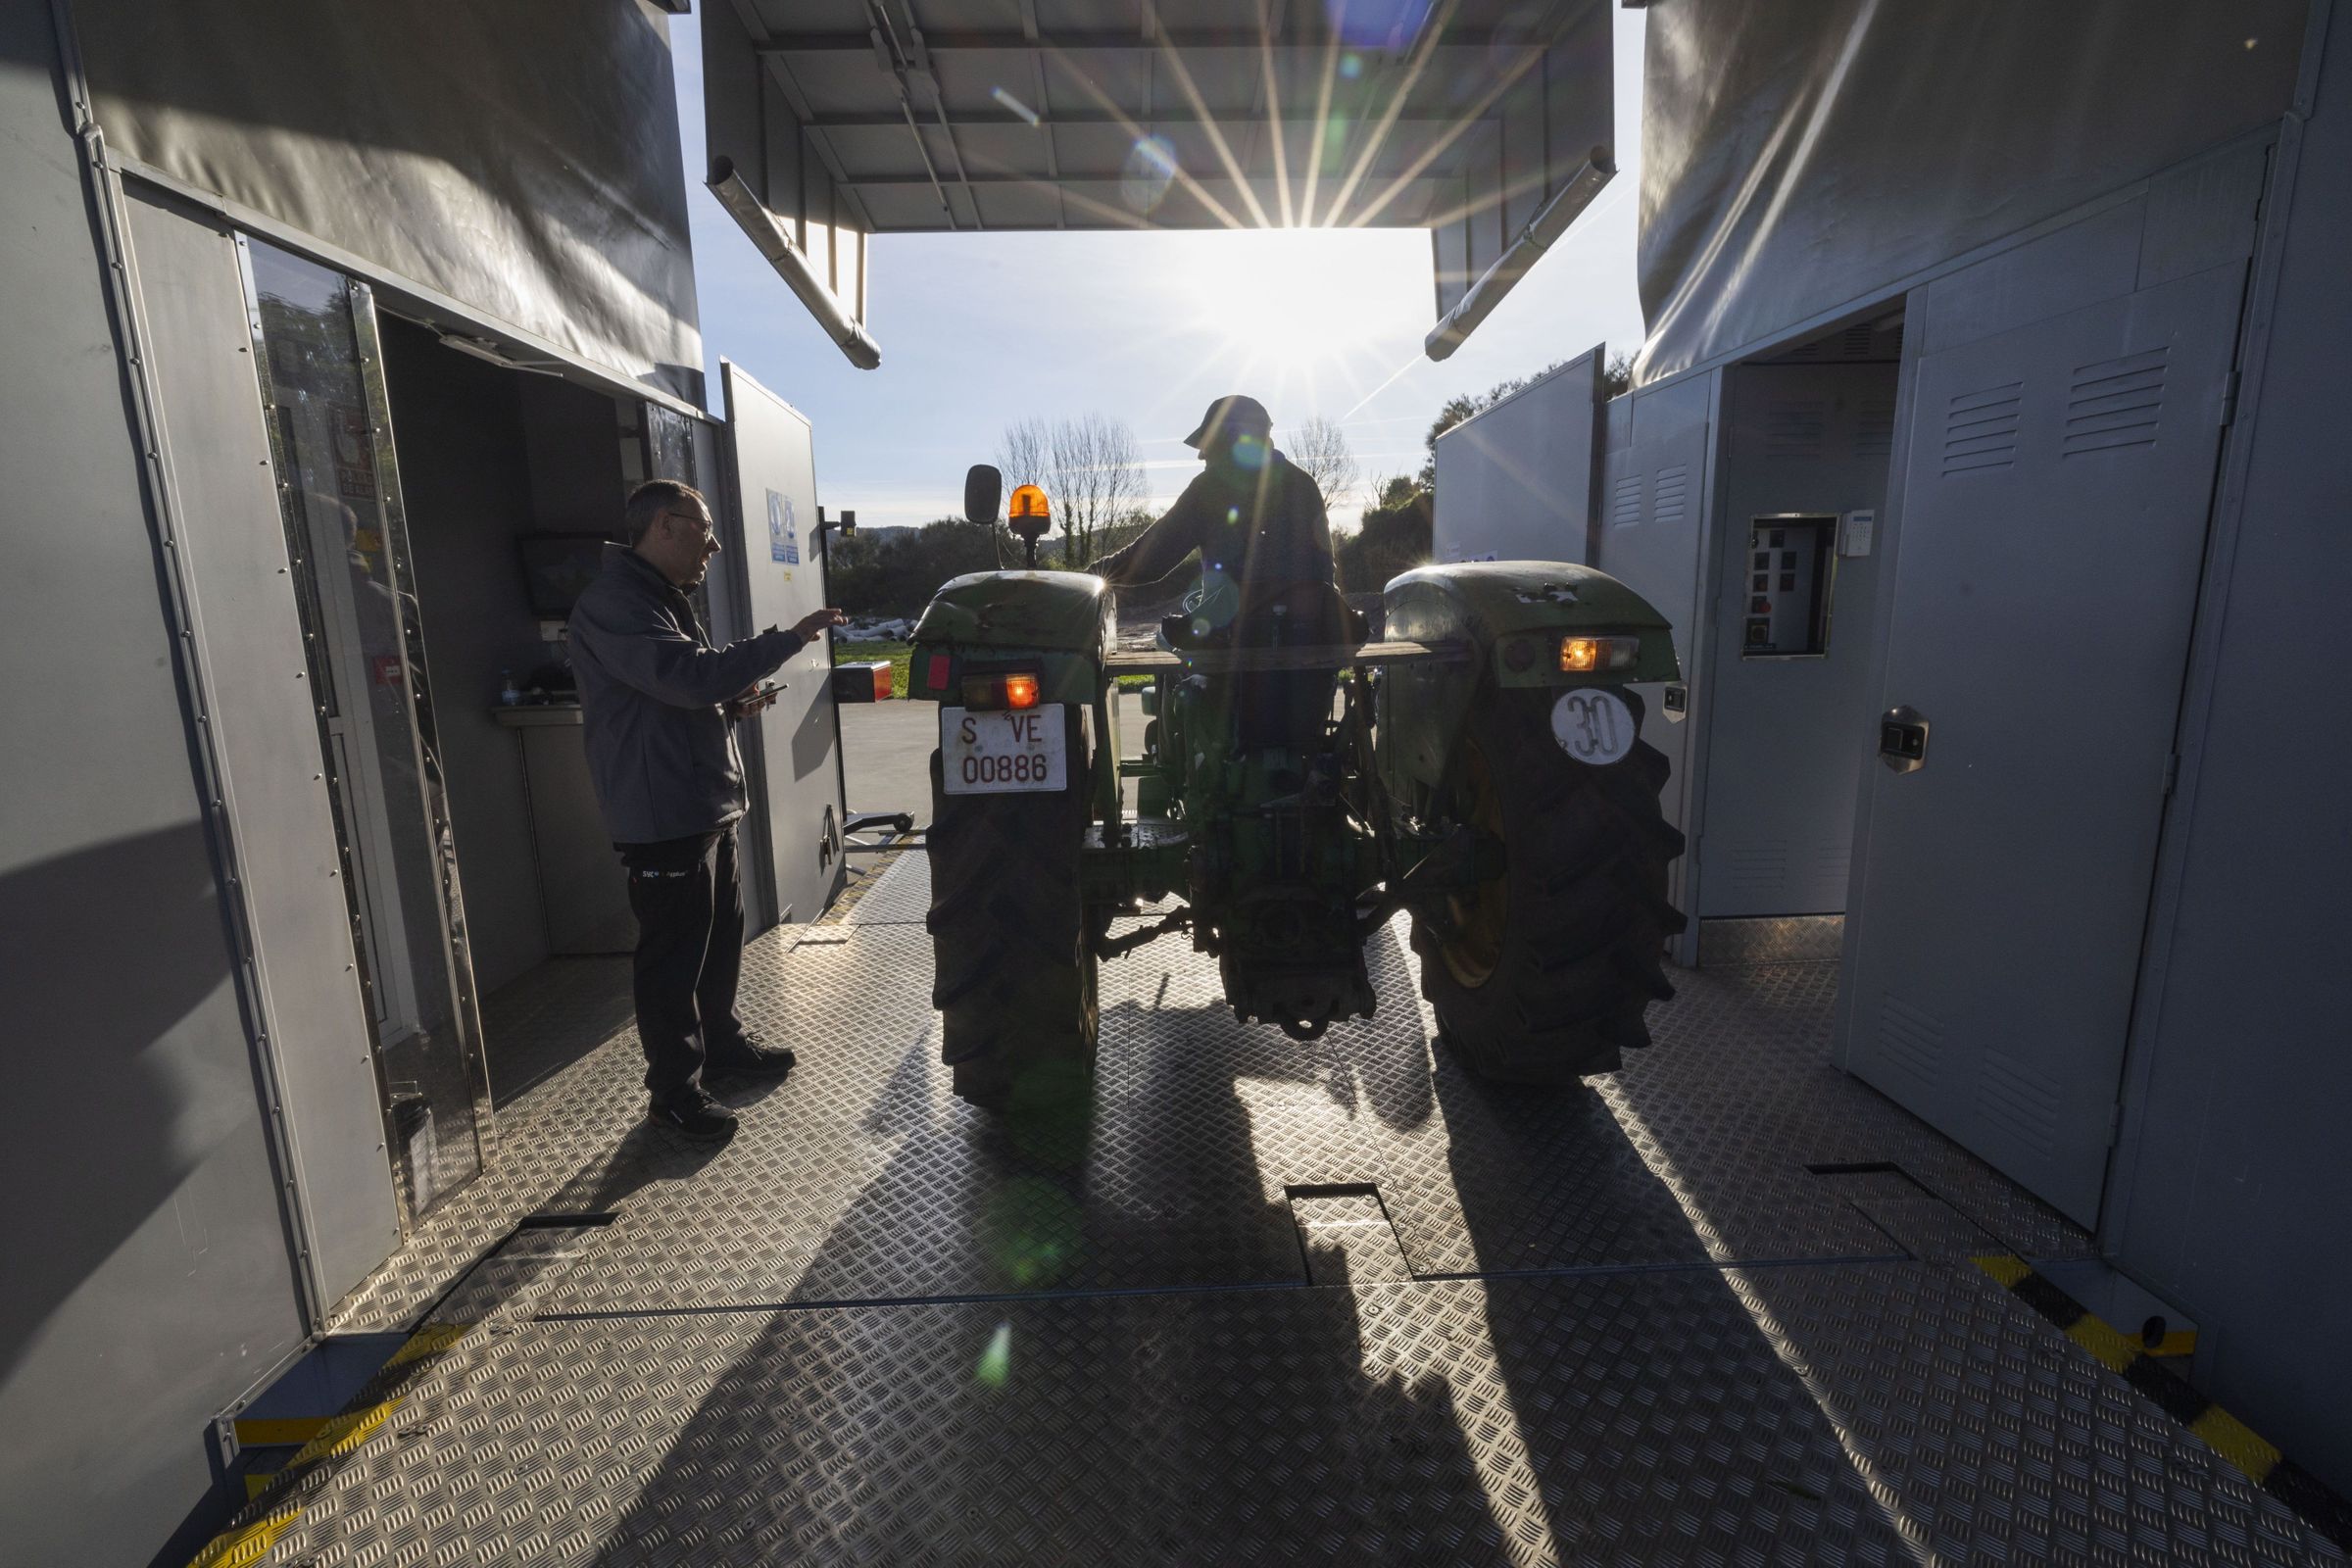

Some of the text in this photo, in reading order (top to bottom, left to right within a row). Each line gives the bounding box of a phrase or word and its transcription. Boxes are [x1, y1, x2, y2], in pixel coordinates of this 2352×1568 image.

[961, 714, 1042, 745] S VE
[1568, 695, 1618, 757] 30
[962, 754, 1048, 784] 00886
